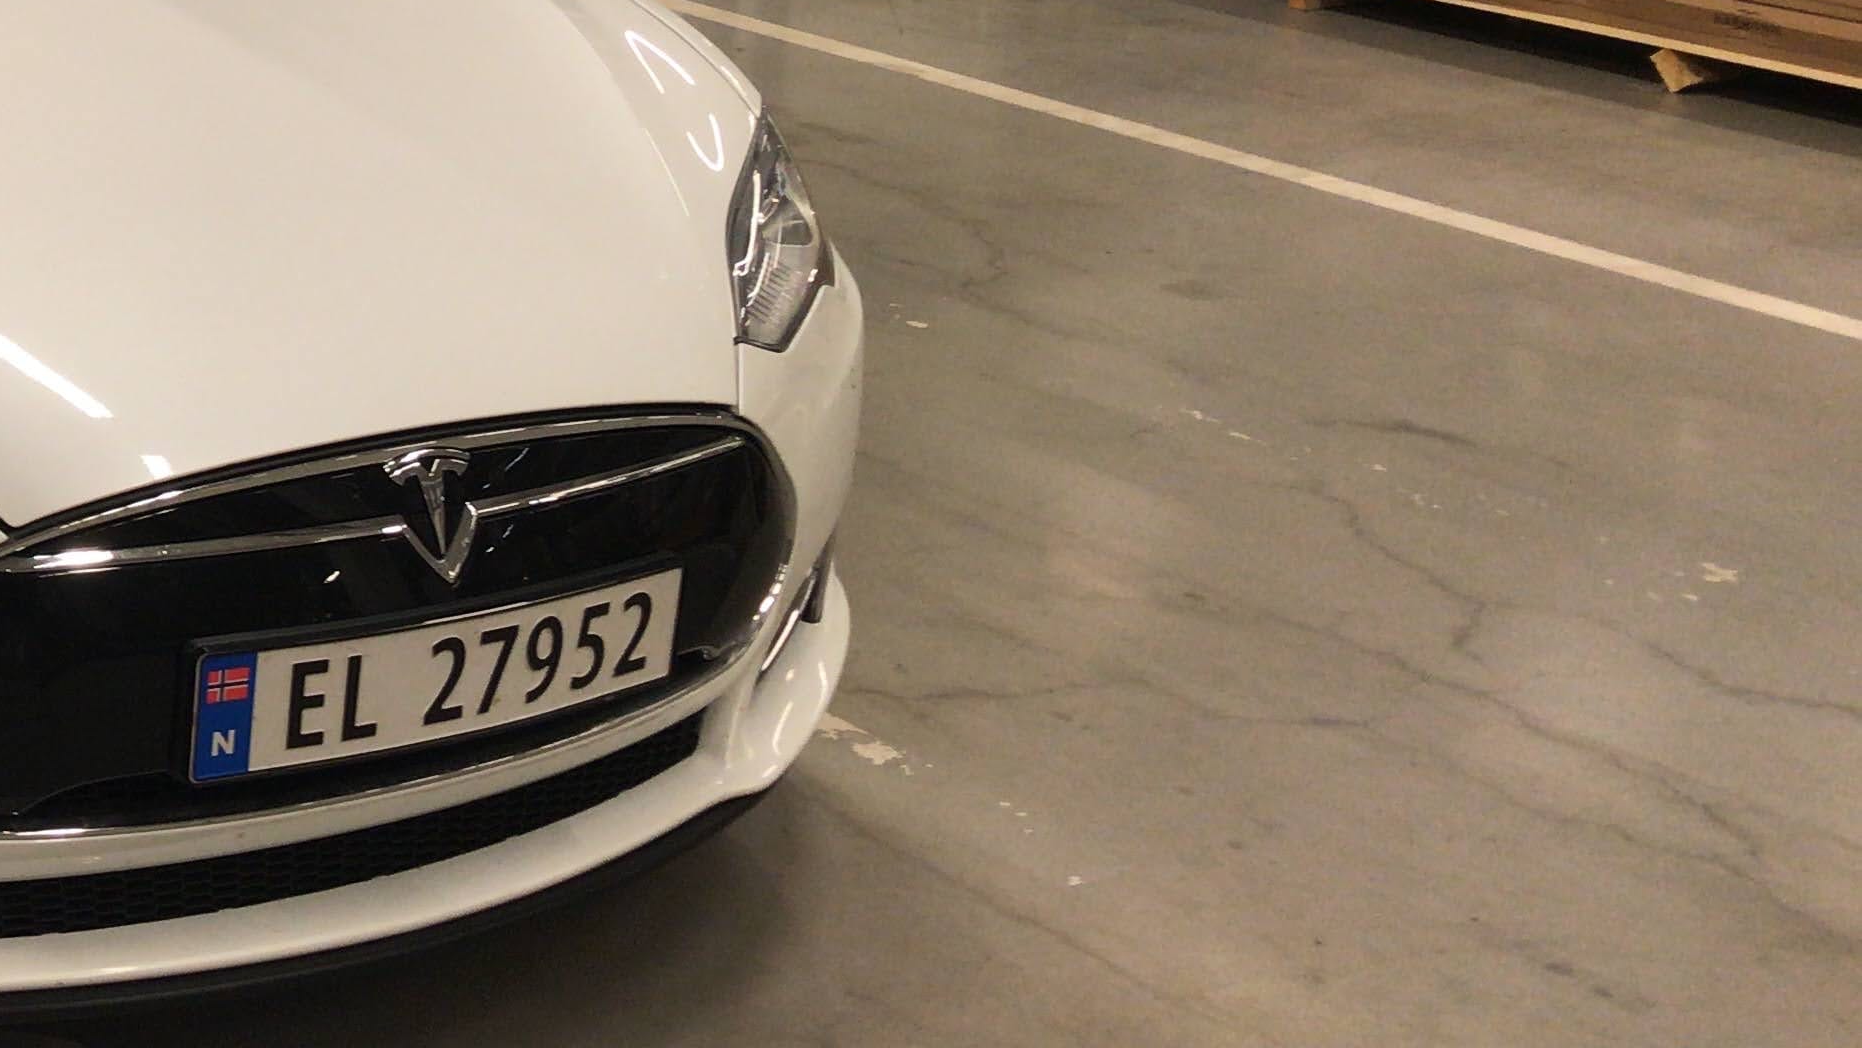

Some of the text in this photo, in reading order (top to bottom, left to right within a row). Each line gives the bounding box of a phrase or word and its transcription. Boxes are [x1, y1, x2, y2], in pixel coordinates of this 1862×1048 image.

[286, 591, 653, 750] EL 27952
[210, 729, 235, 757] N
